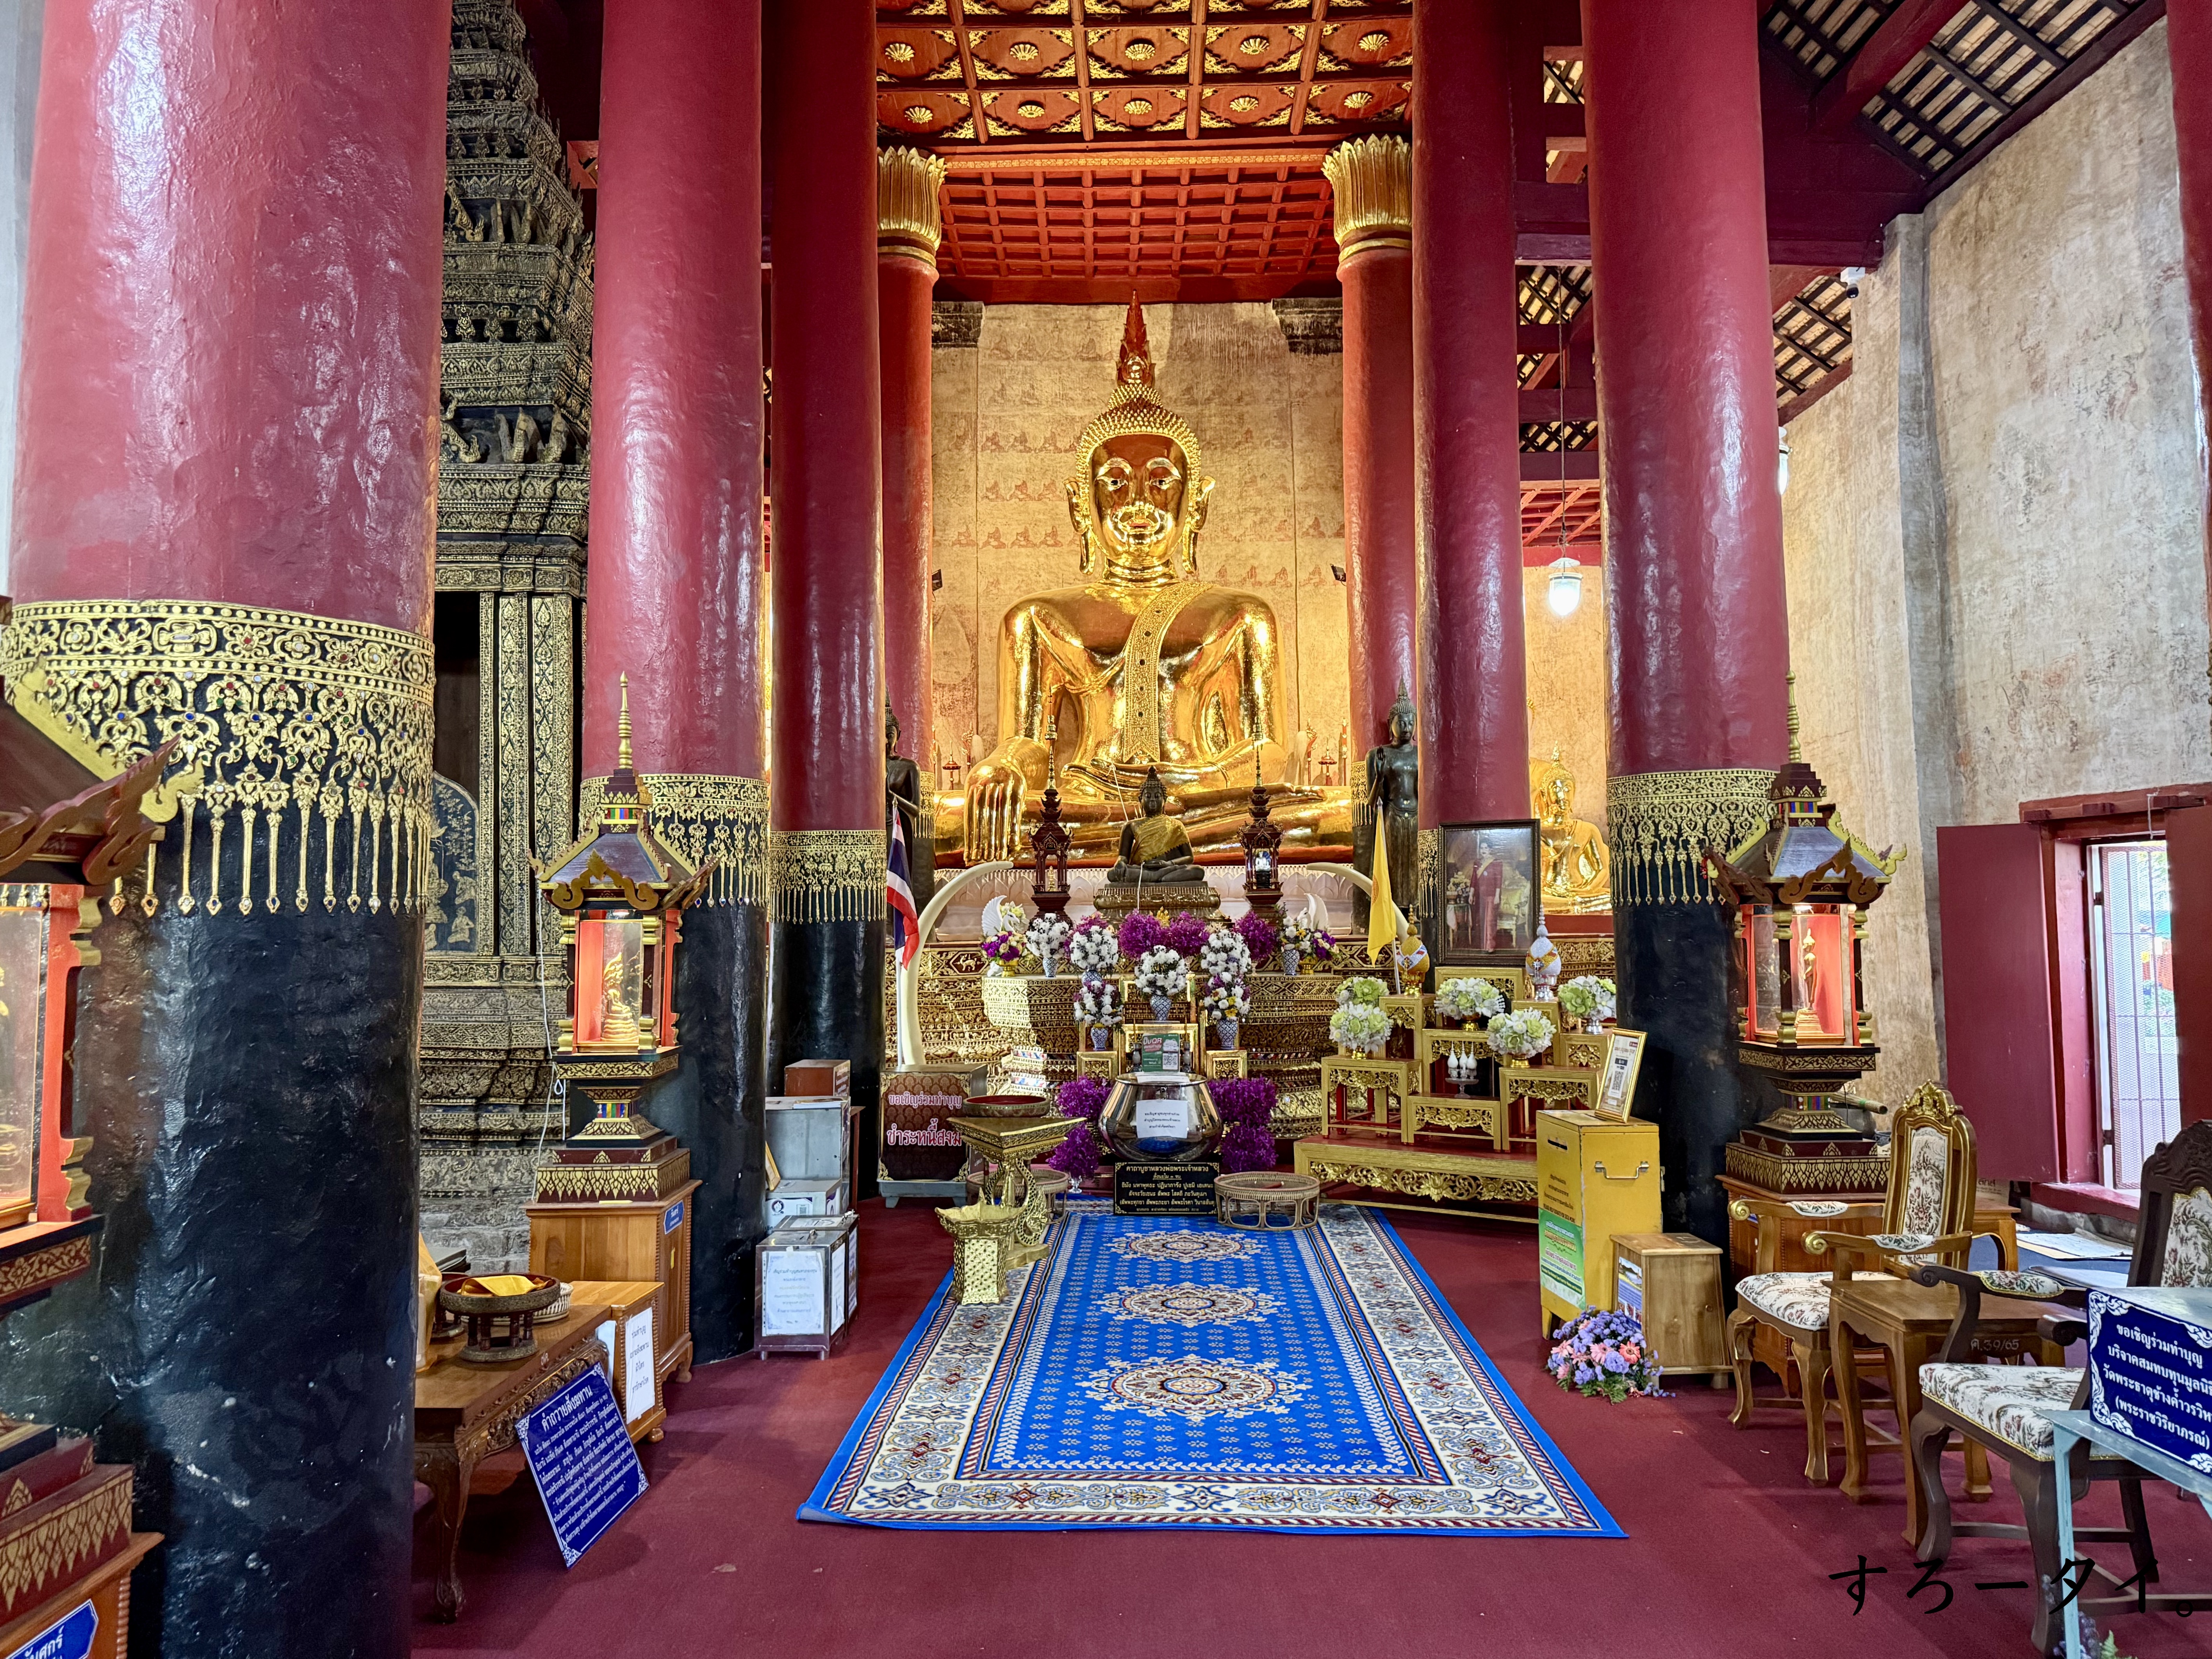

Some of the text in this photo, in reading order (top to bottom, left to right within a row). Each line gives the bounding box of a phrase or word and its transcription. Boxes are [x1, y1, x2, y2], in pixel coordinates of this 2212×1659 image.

[888, 1091, 962, 1110] ขอเชิญร่วมทำบุญ
[887, 1118, 962, 1146] ชำระหนี้สงฆ
[1126, 1165, 1209, 1174] คาถาบูชาหลวงพ่อพระเจ้าหลวง
[2116, 1324, 2203, 1369] ขอเชิญร่วมทำบุญ
[542, 1385, 593, 1432] คำถวายสังฆทาน
[2103, 1363, 2212, 1423] วัดพระธาตุช้างค้ำวรวิห
[2115, 1395, 2210, 1450] (พระราชวิริยาภรณ์)
